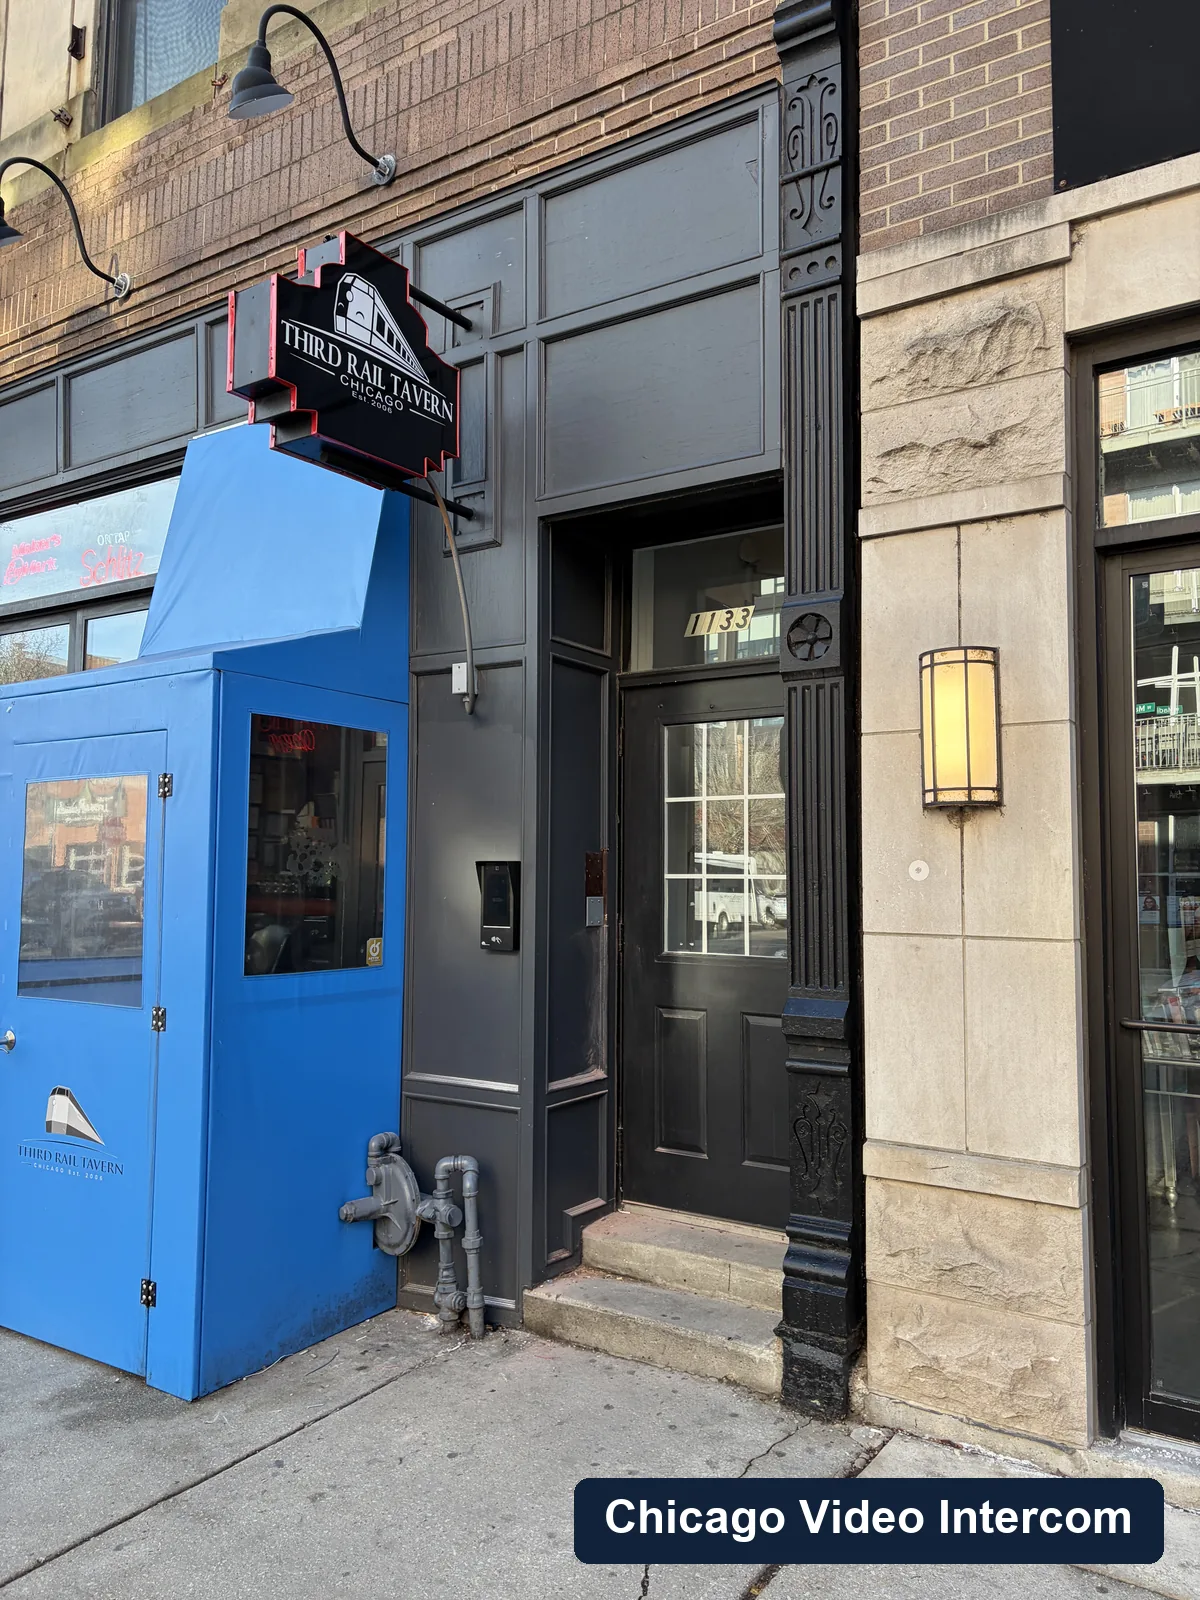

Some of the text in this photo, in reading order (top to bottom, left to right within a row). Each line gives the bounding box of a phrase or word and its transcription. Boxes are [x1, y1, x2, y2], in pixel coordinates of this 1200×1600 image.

[281, 319, 453, 423] THIRD RAIL TAVERN
[340, 374, 404, 411] CHICAGO
[79, 545, 145, 587] Schlitz
[691, 608, 751, 634] 1133
[17, 1144, 124, 1175] THIRD RAIL TAVERN
[33, 1162, 64, 1174] CHICAGO
